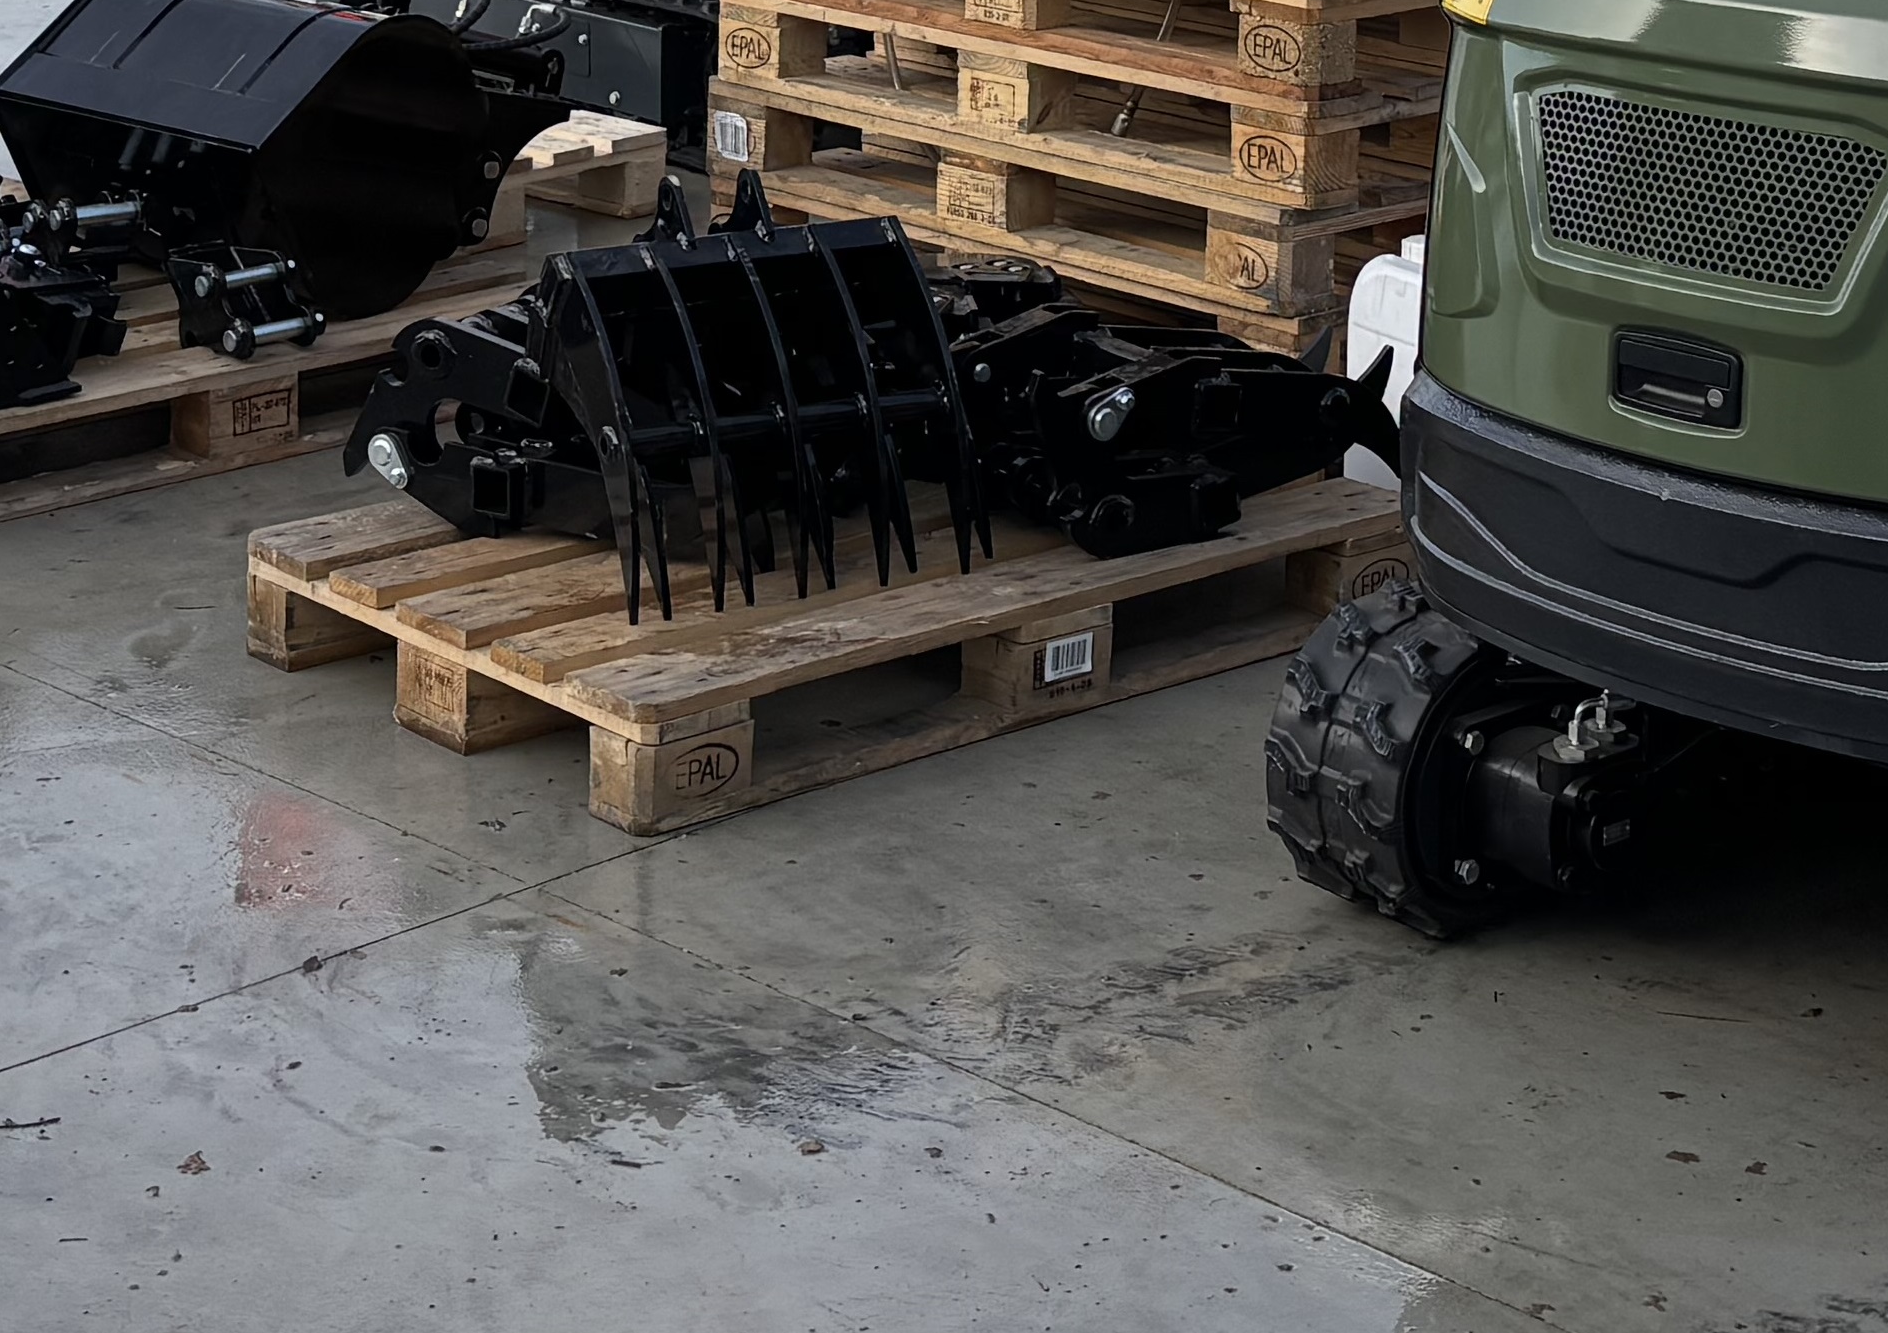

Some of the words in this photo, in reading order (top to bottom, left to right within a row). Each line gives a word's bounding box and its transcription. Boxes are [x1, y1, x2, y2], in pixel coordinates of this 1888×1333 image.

[731, 34, 766, 60] EPAL
[1252, 32, 1292, 65] EPAL
[1247, 142, 1291, 173] EPAL
[676, 752, 728, 790] EPAL
